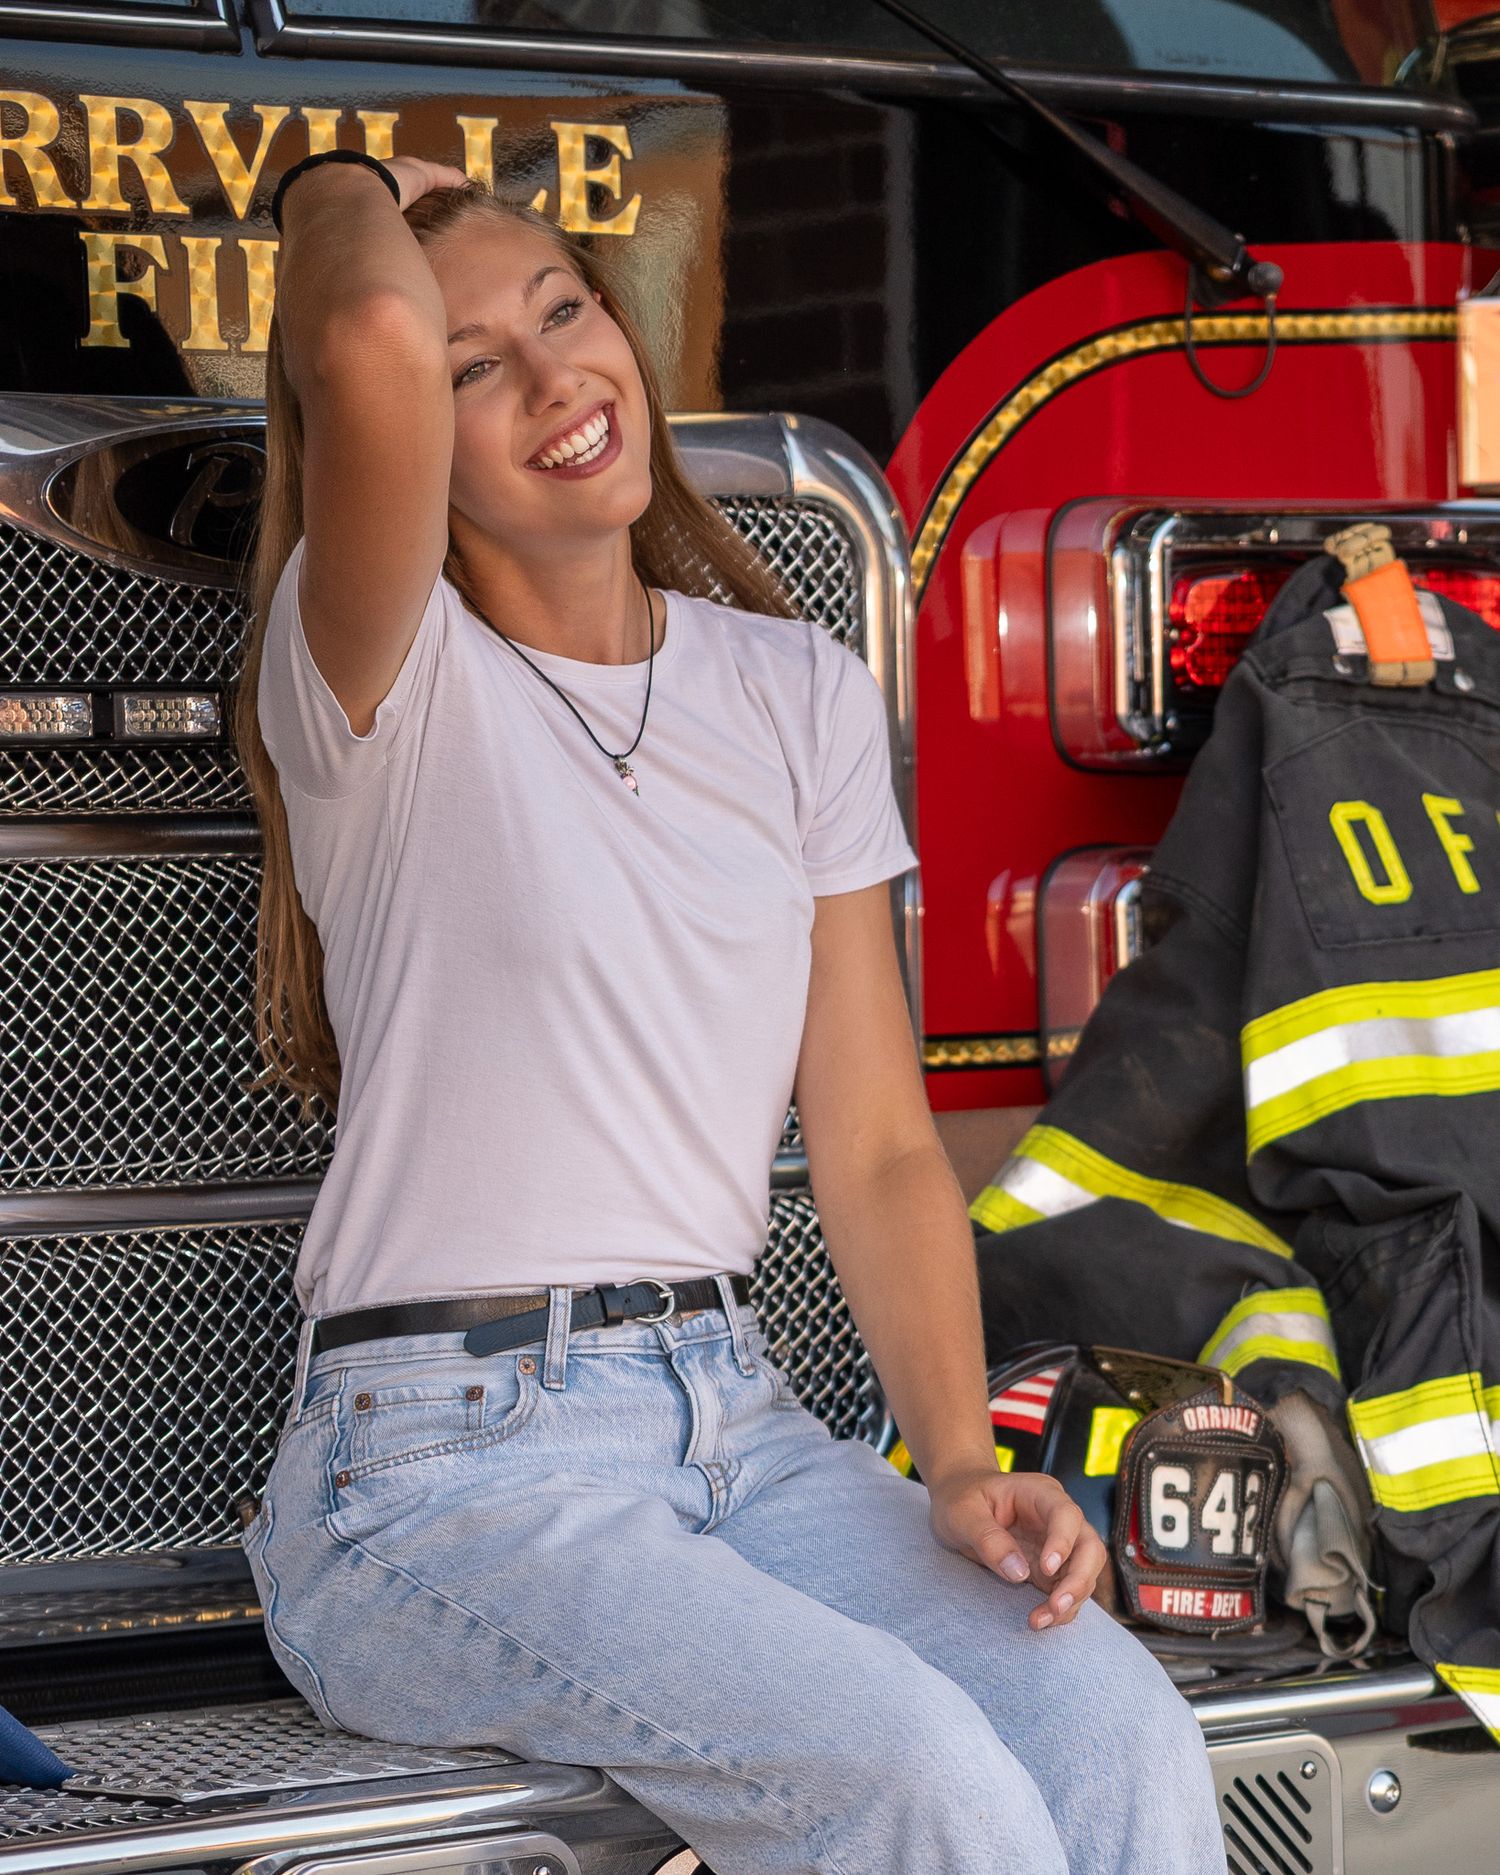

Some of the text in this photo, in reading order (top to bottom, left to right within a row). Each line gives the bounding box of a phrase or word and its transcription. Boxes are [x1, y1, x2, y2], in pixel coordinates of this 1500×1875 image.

[1329, 792, 1500, 906] OF
[1183, 1405, 1258, 1437] ORRVILLE
[1161, 1589, 1243, 1617] FIRE DEPT
